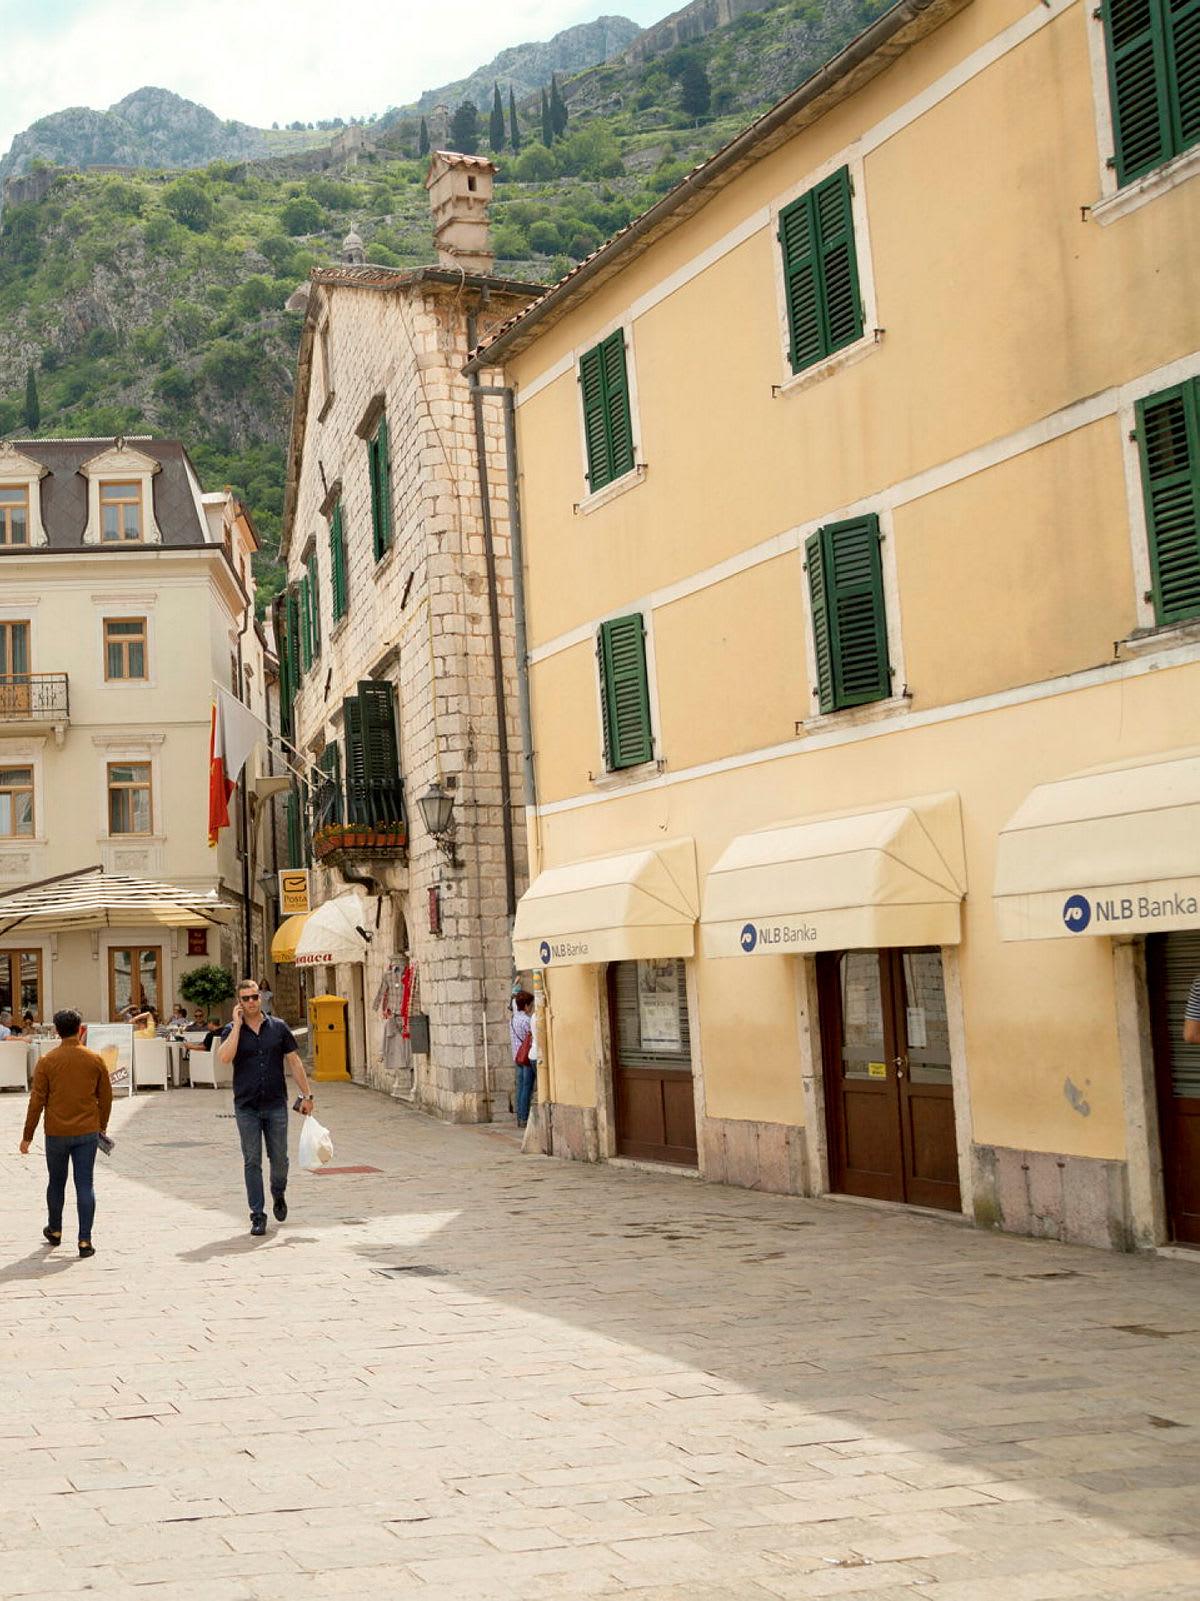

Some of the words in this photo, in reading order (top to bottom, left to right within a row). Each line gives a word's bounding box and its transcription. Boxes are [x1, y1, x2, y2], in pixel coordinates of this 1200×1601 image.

[1096, 899, 1134, 921] NLB
[1138, 892, 1198, 918] Banka
[759, 927, 781, 944] NLB
[783, 924, 817, 943] Banka
[552, 943, 567, 957] NLB
[567, 942, 589, 956] Banka
